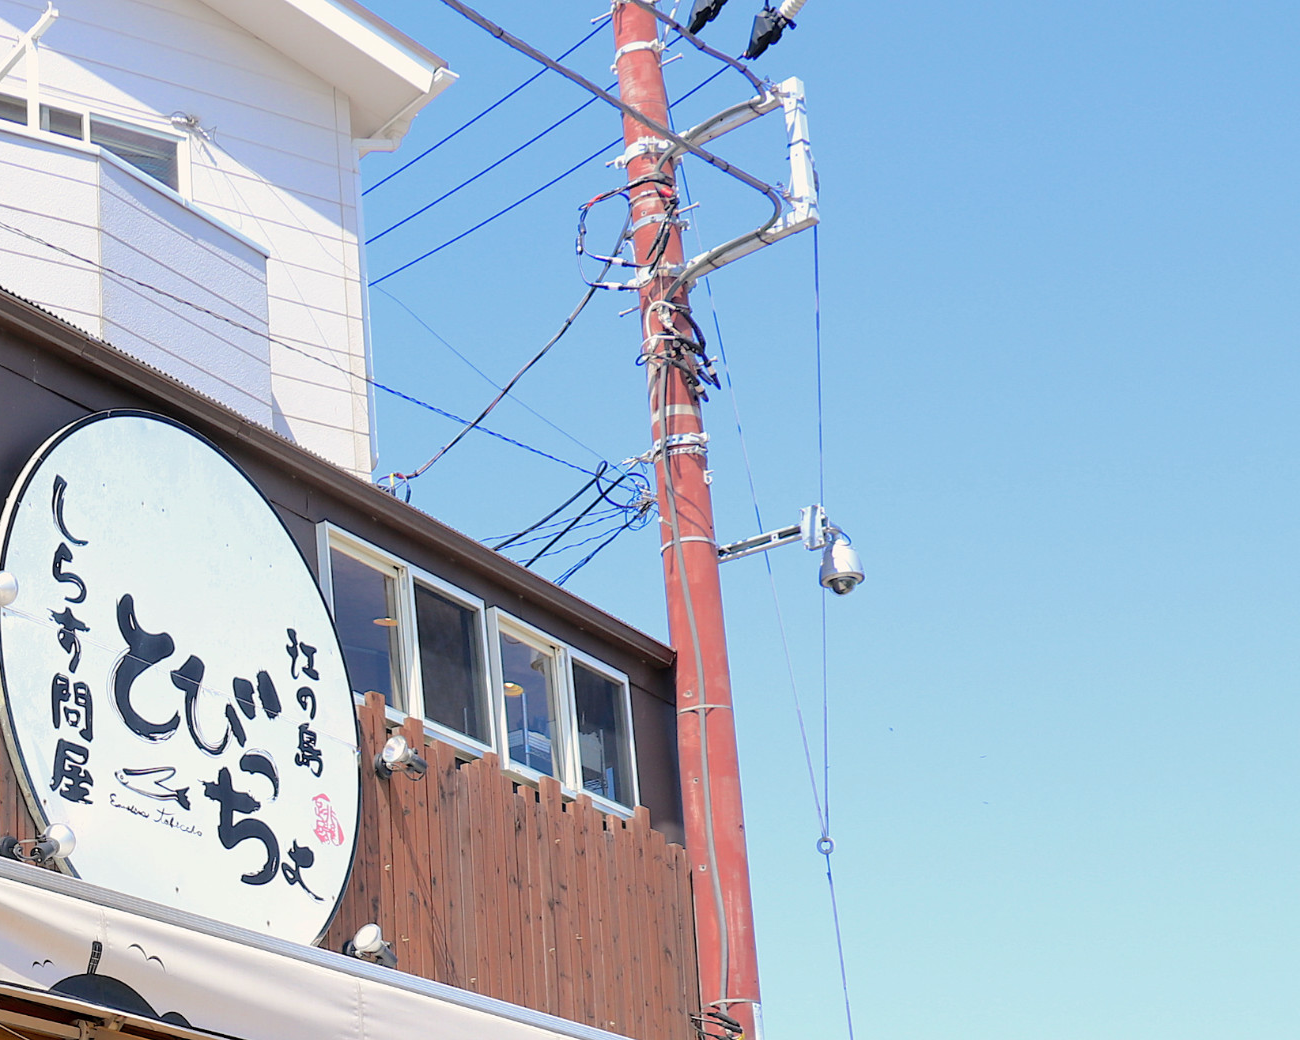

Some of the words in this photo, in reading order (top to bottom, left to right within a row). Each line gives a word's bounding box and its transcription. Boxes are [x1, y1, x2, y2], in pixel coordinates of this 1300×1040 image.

[49, 474, 94, 805] しらす問屋
[106, 593, 324, 901] とびっちょ
[287, 628, 320, 777] 江の島
